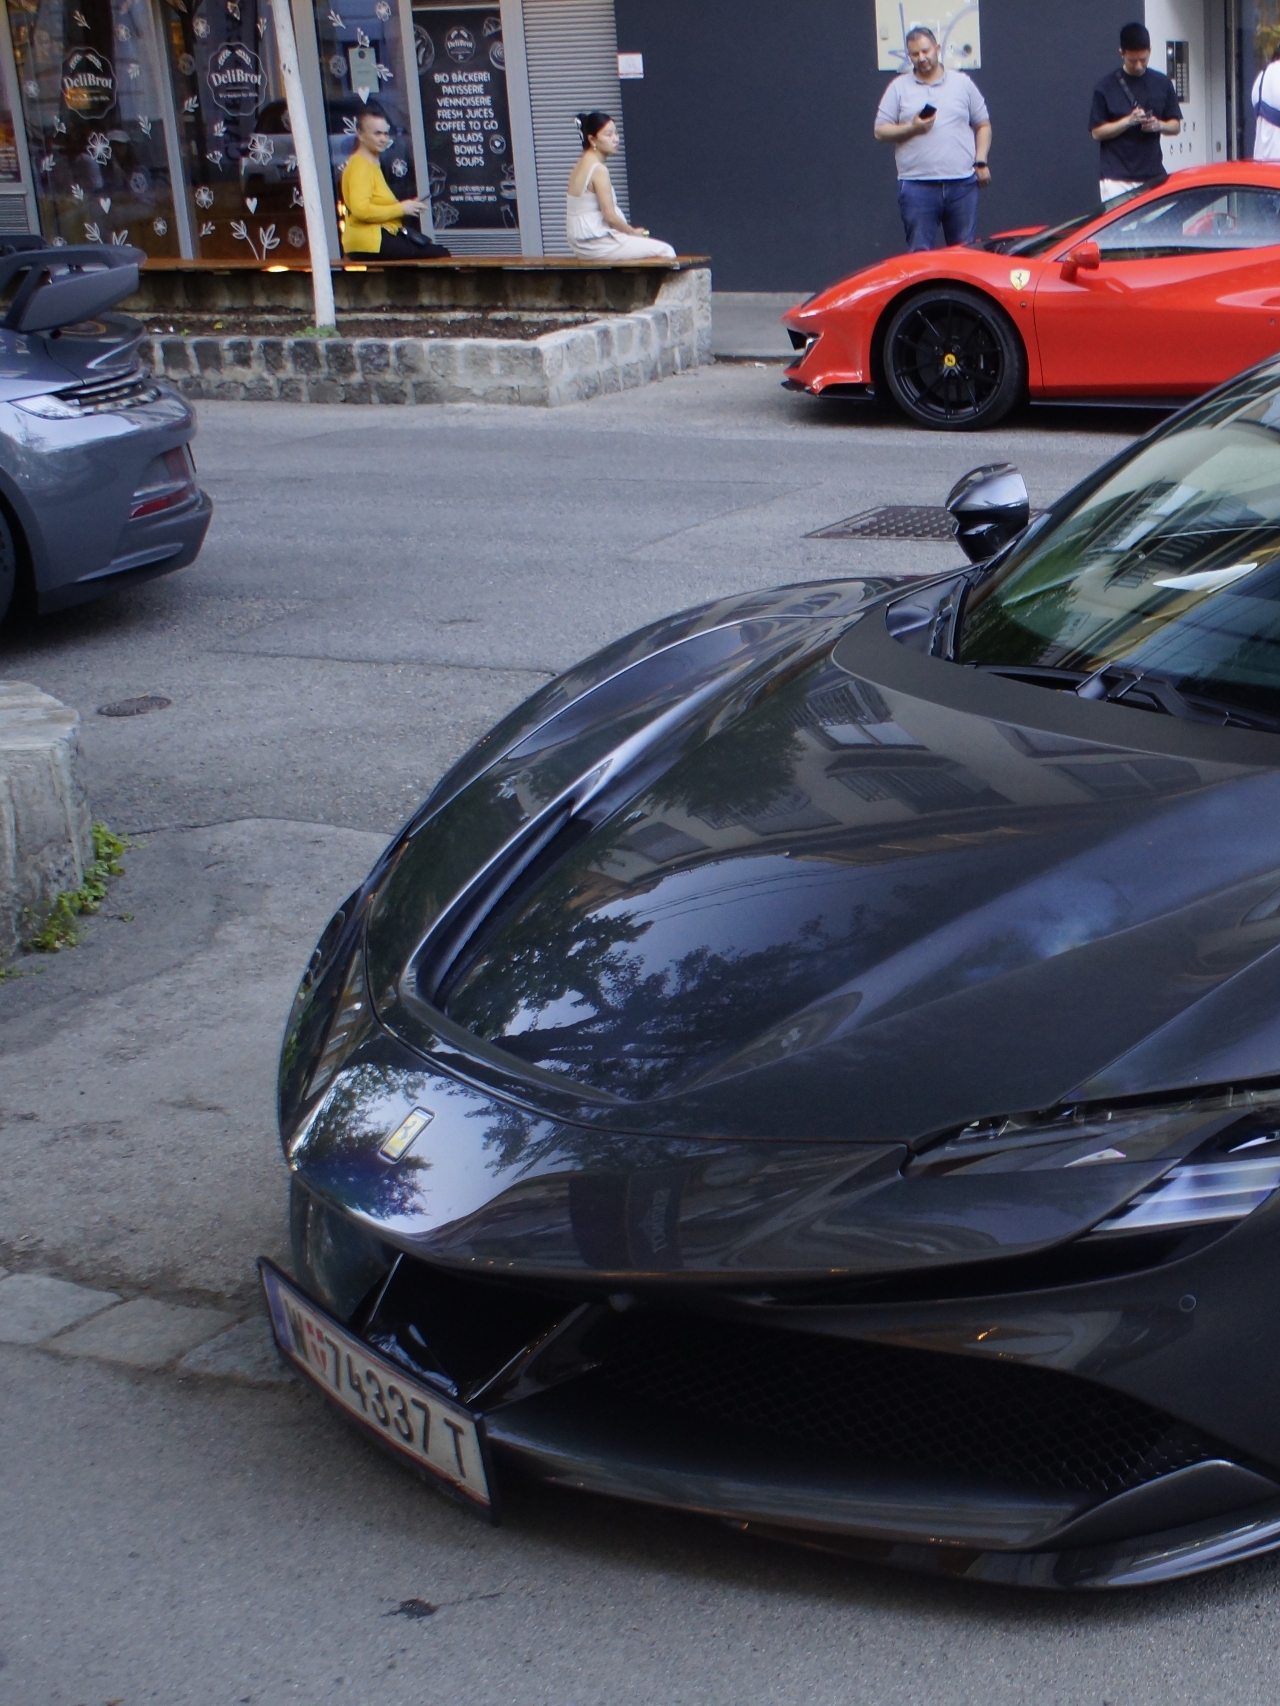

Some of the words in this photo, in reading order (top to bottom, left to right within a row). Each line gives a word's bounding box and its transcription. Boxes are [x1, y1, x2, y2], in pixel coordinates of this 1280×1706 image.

[62, 72, 113, 89] DeliBrot
[210, 68, 262, 87] DeliBrot
[434, 73, 449, 83] BIO
[452, 71, 491, 83] BÄCKEREI
[442, 84, 485, 95] PATISSERIE
[437, 96, 492, 107] VIENNOISERIE
[437, 109, 463, 119] FRESH
[465, 108, 494, 119] JUICES
[435, 122, 466, 132] COFFEE
[469, 121, 481, 131] TO
[483, 121, 498, 130] GO
[452, 132, 484, 143] SALADS
[454, 145, 484, 155] BOWLS
[455, 157, 485, 167] SOUPS
[325, 1335, 432, 1455] 74337
[443, 1417, 466, 1479] T
